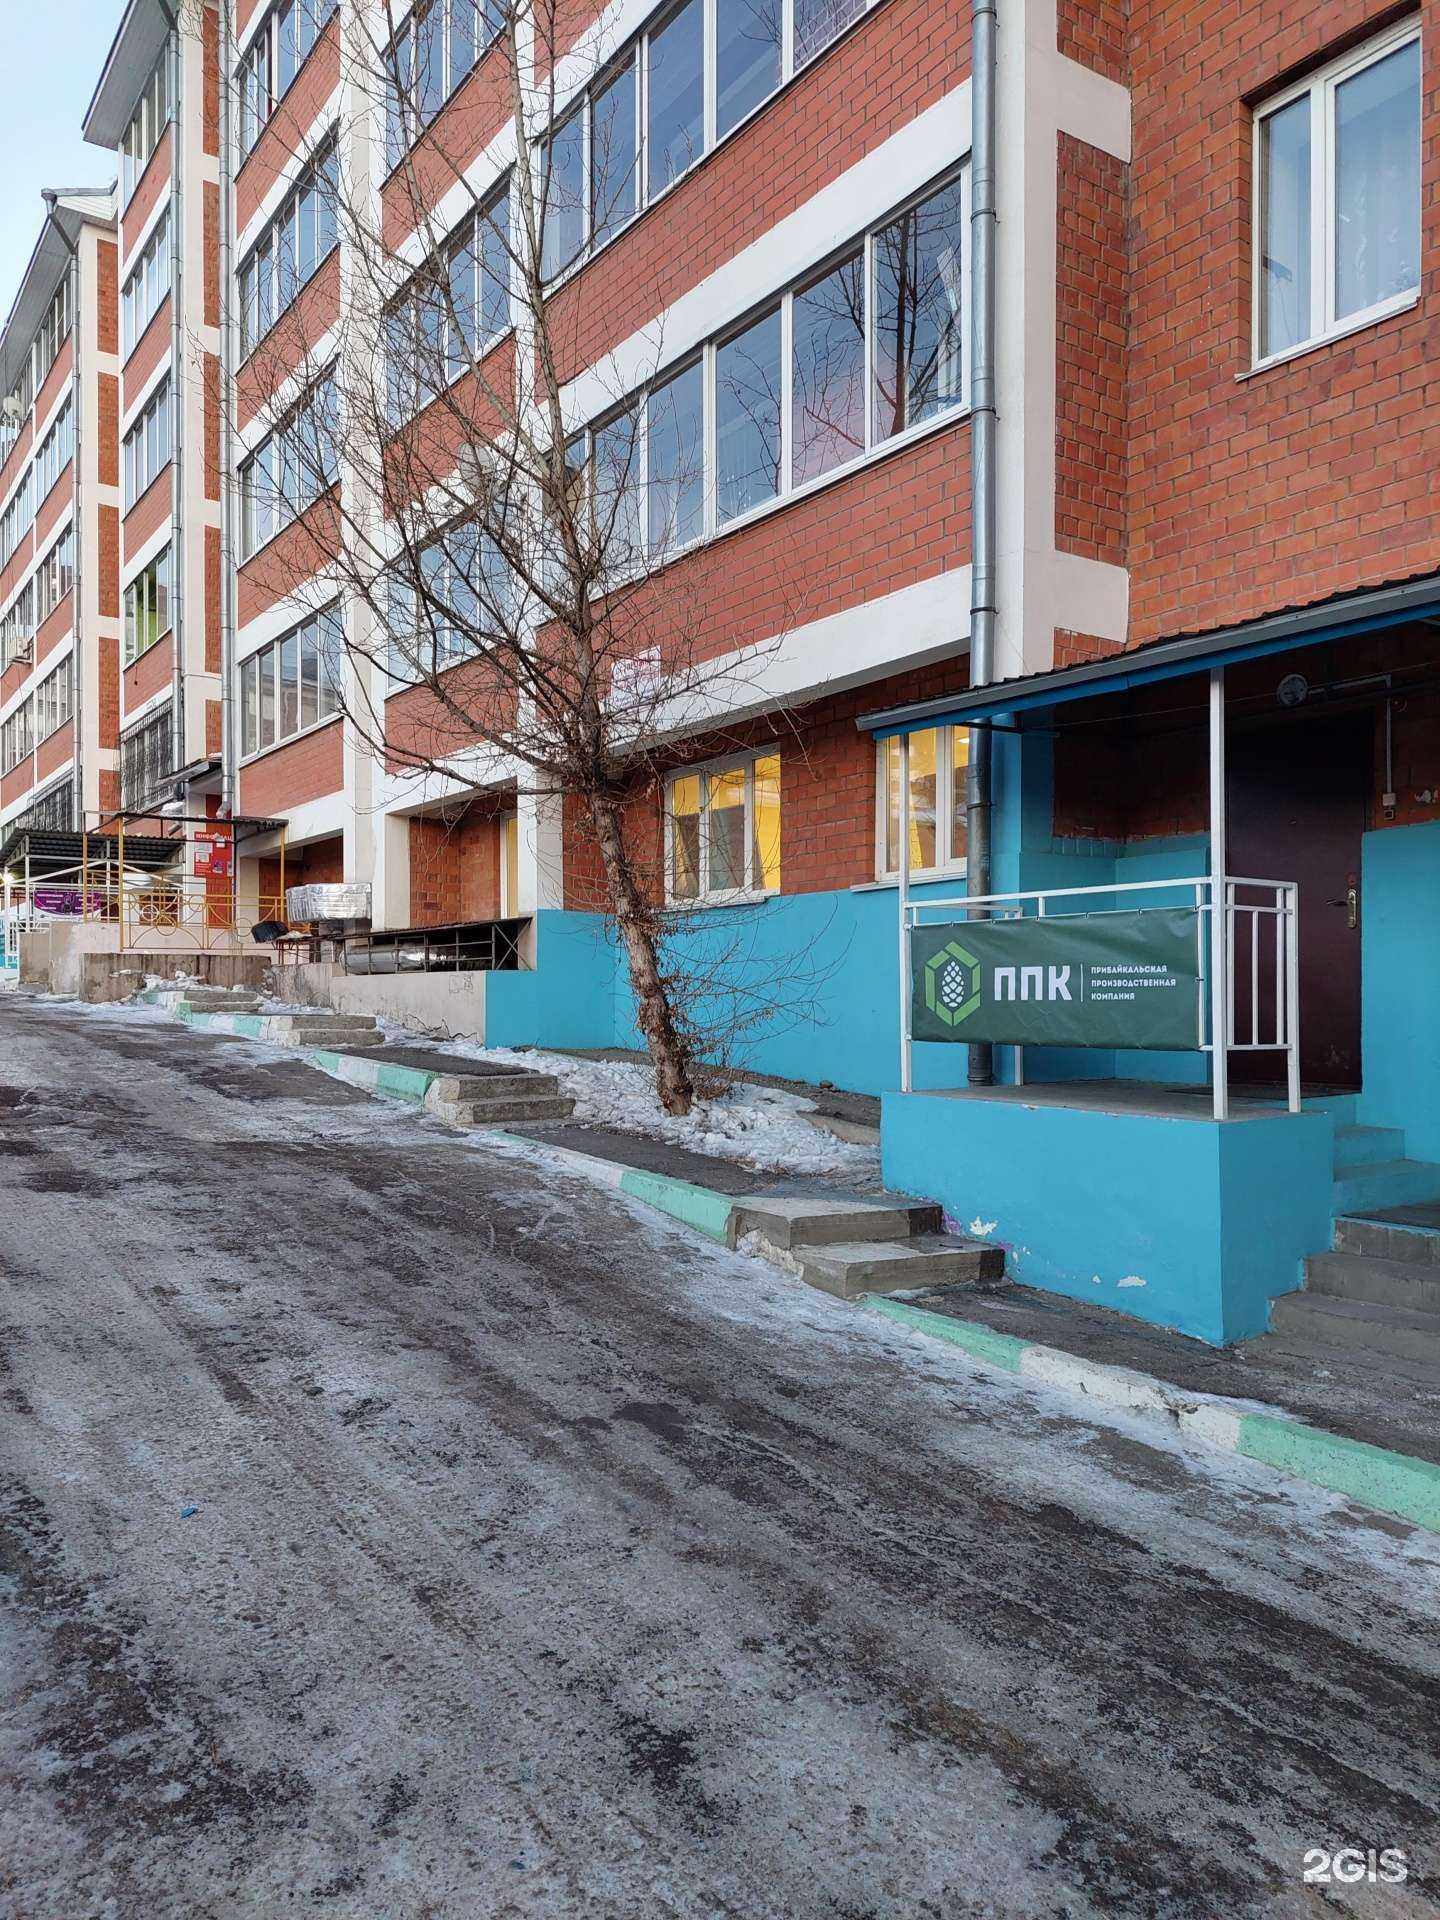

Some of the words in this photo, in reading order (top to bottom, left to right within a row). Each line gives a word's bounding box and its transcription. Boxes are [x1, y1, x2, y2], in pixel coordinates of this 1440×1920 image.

[1091, 964, 1168, 974] ПРИБАЙКАЛЬСКАЯ
[994, 965, 1073, 1001] ППК
[1091, 979, 1177, 988] ПРОИЗВОДСТВЕННАЯ
[1091, 992, 1136, 1001] КОМПАНИЯ
